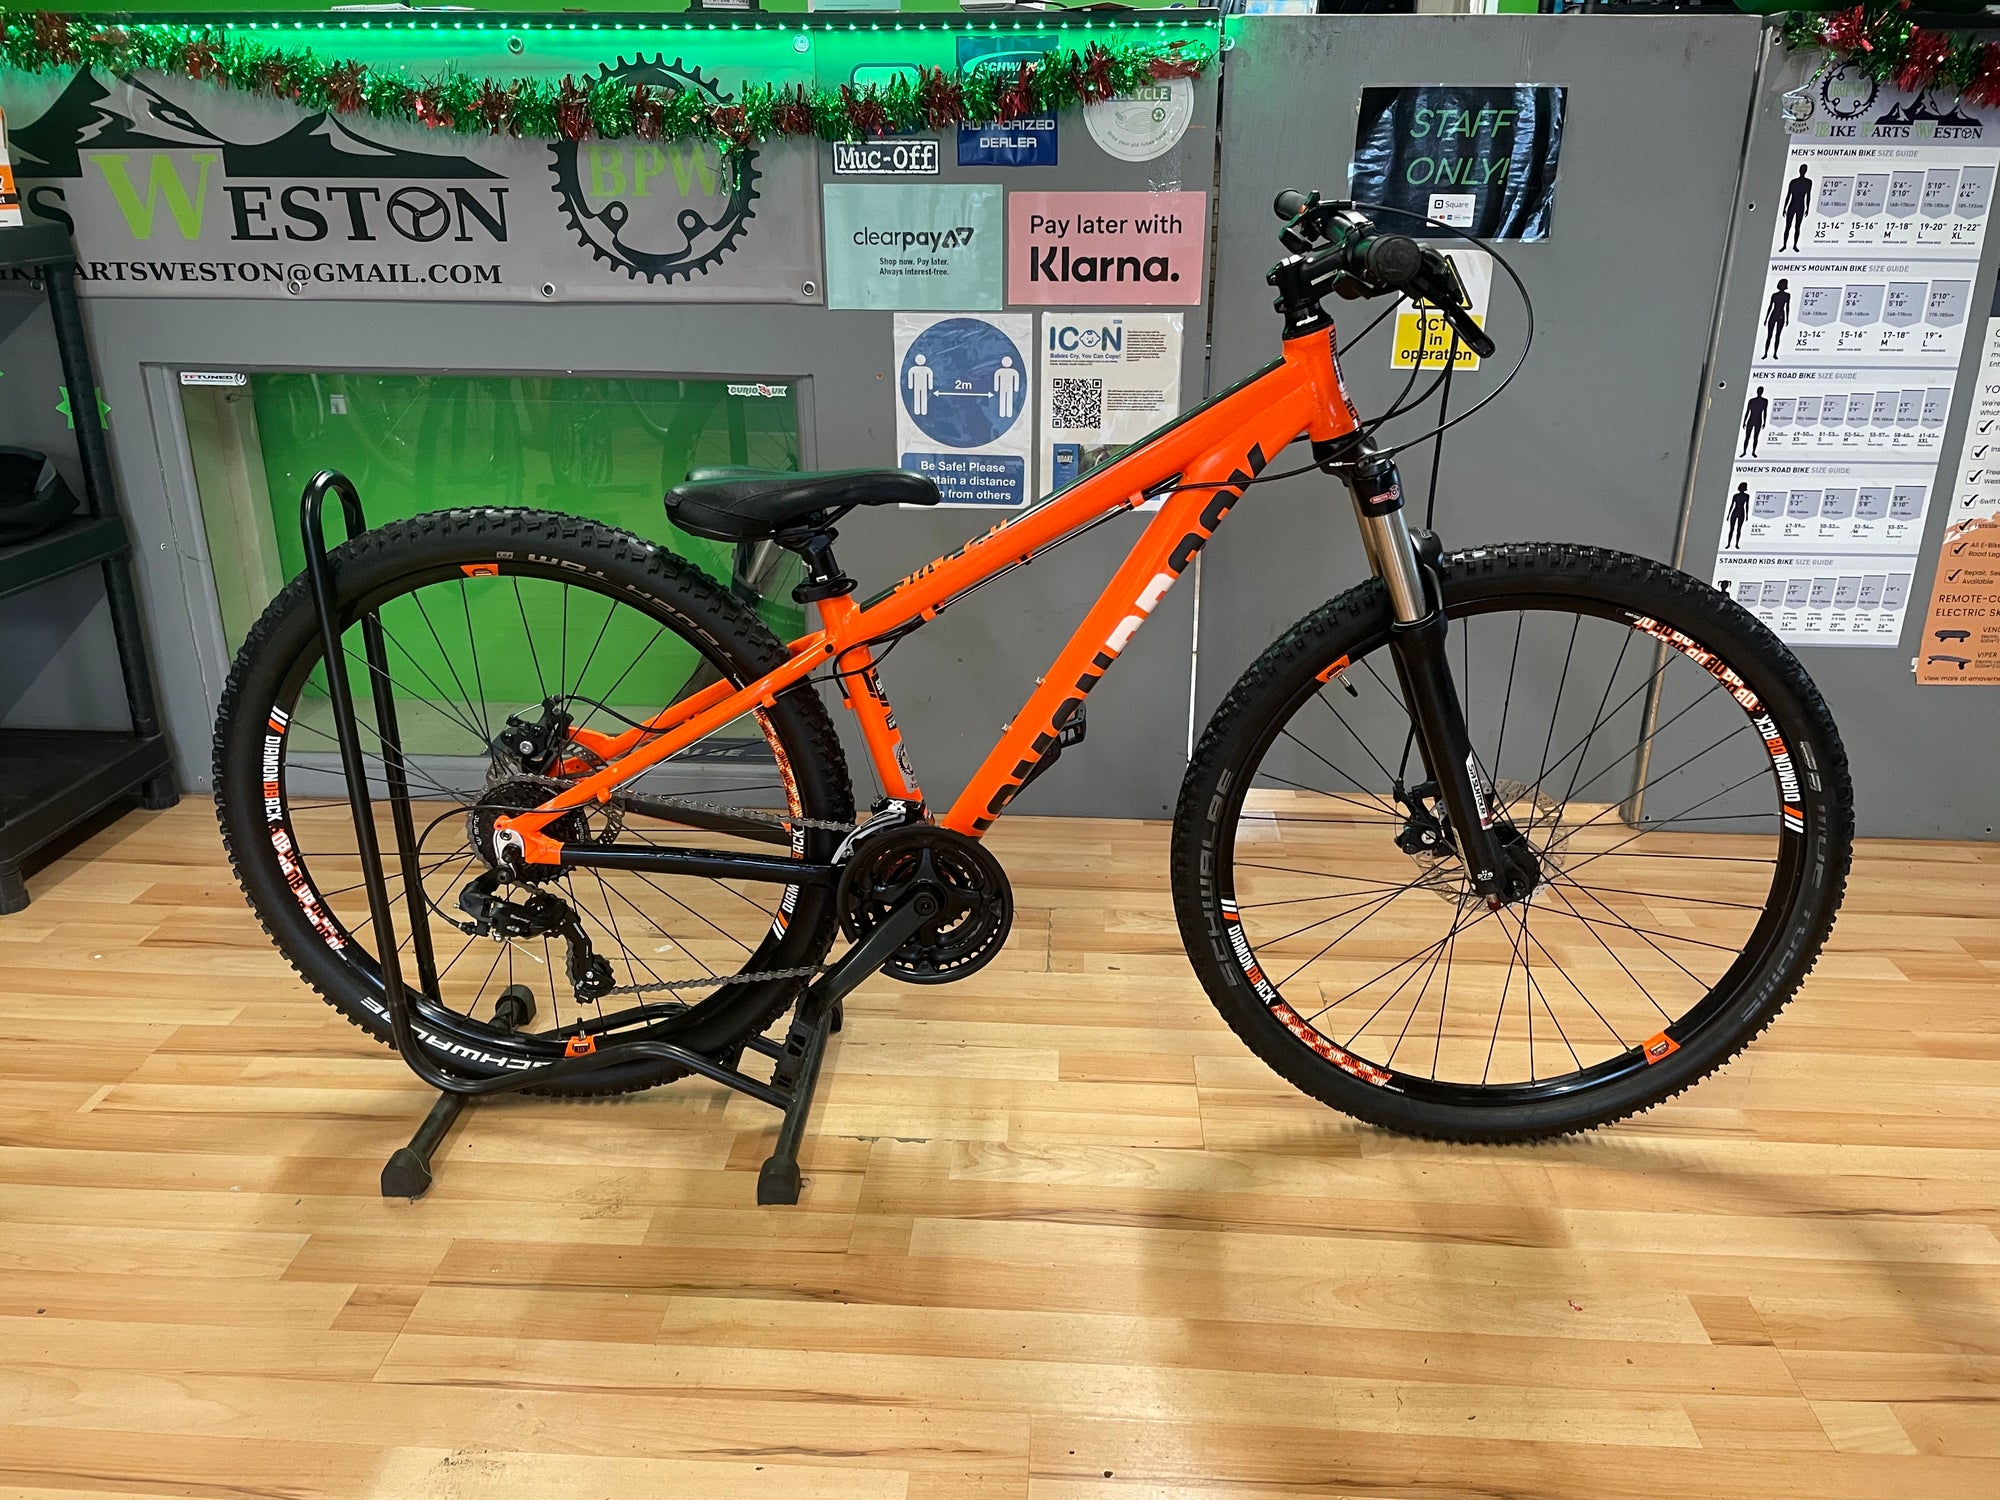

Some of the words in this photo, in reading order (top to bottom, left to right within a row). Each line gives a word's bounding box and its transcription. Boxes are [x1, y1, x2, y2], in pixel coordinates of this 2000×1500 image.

[1410, 110, 1519, 138] STAFF
[1815, 122, 1856, 138] BIKE
[1861, 122, 1910, 138] PARTS
[980, 138, 1036, 147] DEALER
[839, 145, 935, 169] Muc-Off
[1791, 149, 1815, 157] MEN'S
[585, 145, 721, 197] BPW
[1406, 158, 1511, 185] ONLY!
[1031, 214, 1070, 238] Pay
[1078, 214, 1128, 233] later
[1135, 214, 1182, 233] with
[854, 227, 942, 252] clearpay
[1884, 231, 1891, 239] M
[1918, 231, 1923, 239] L
[1952, 232, 1962, 240] XL
[917, 258, 929, 266] Pay
[1030, 246, 1180, 282] Klarna.
[880, 268, 903, 276] Always
[1417, 319, 1447, 331] CCT
[1430, 333, 1442, 345] in
[1402, 349, 1471, 362] operaton
[955, 379, 972, 390] 2m
[921, 461, 935, 470] Be
[938, 461, 966, 471] Safe!
[969, 462, 1005, 472] Please
[970, 477, 1016, 486] distance
[948, 489, 973, 499] from
[976, 490, 1011, 500] others
[1935, 608, 1986, 617] ELECTRIC
[1753, 713, 1801, 803] DIAMONDBACK
[263, 734, 283, 823] DIAMONDBACK
[1472, 777, 1487, 815] SUNTOUR
[1199, 767, 1242, 987] SCHWALBE
[1227, 923, 1277, 1005] DIAMONDBACK
[359, 995, 554, 1071] CHWALE
